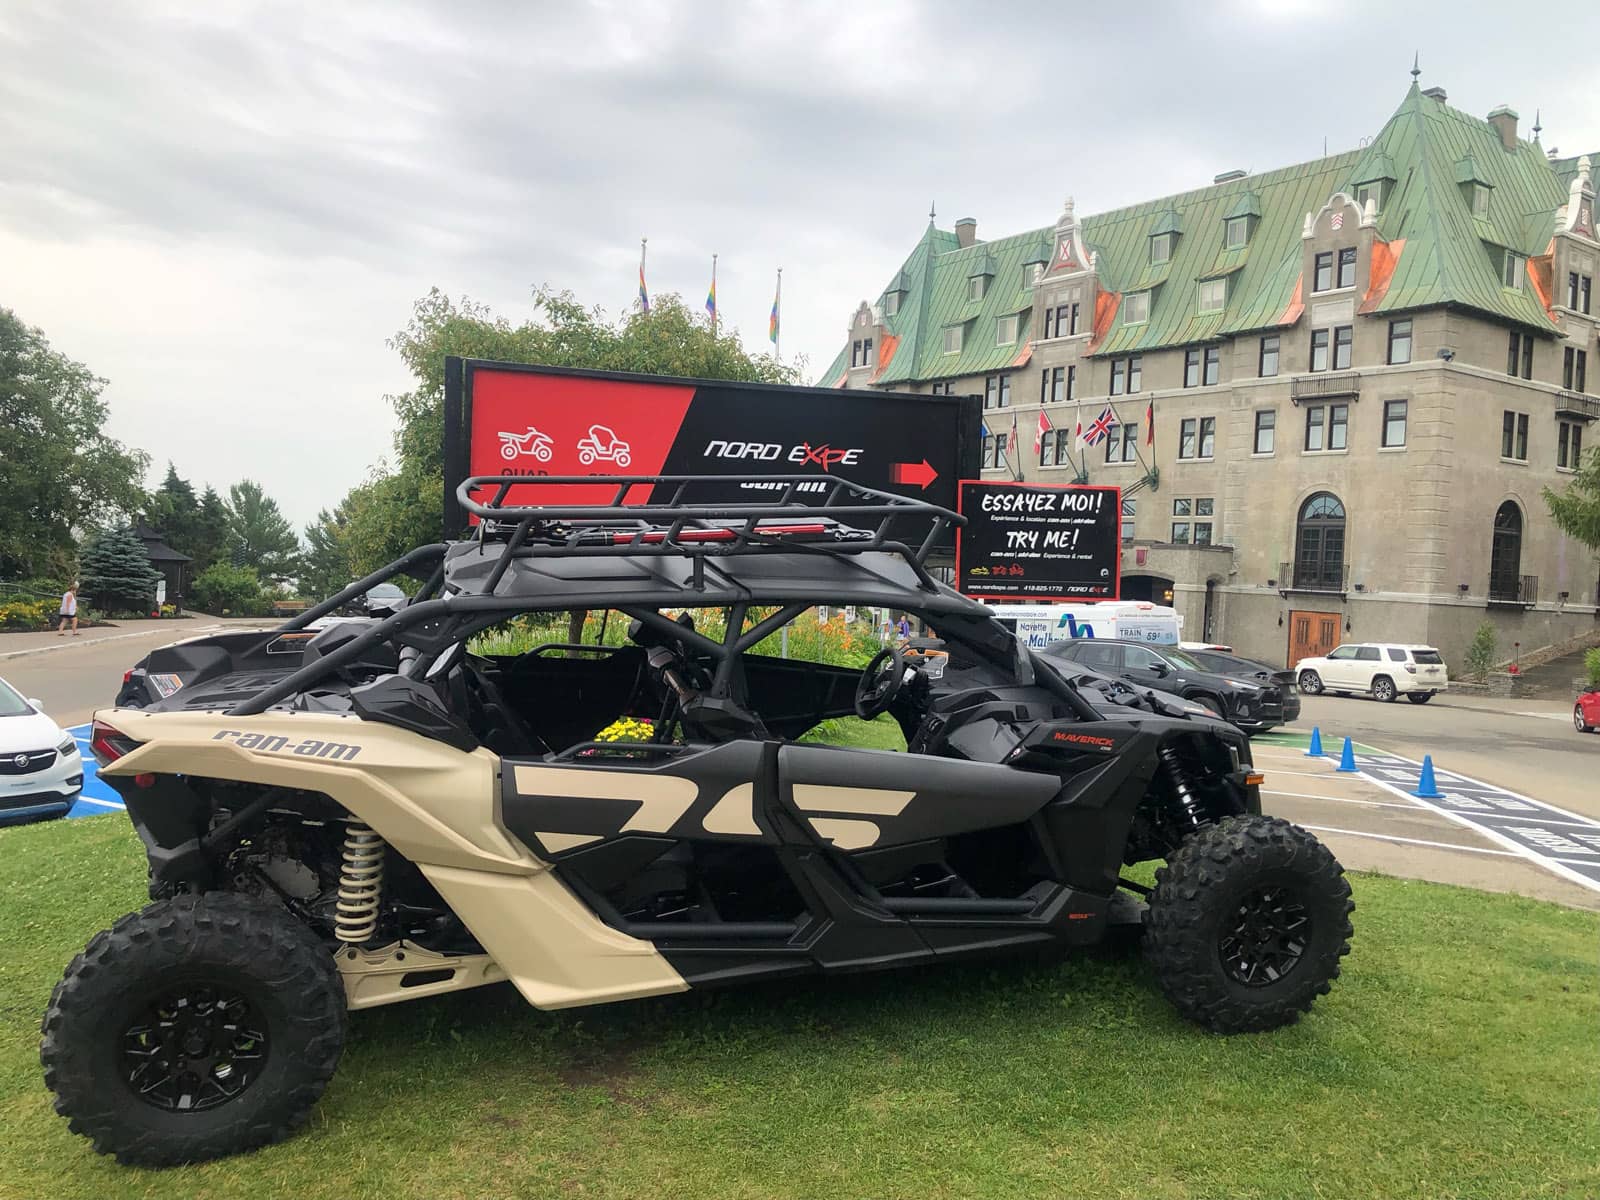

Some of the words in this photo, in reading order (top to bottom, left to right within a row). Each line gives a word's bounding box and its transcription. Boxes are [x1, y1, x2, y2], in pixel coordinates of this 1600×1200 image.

[704, 440, 782, 461] NORD
[788, 438, 864, 472] EXPE
[981, 493, 1057, 513] ESSAYEZ
[1060, 492, 1103, 514] MOI!
[1006, 530, 1039, 549] TRY
[1043, 528, 1079, 550] ME!
[1020, 623, 1047, 632] Navette
[1120, 629, 1141, 637] TRAIN
[1054, 732, 1114, 746] MAVERICK
